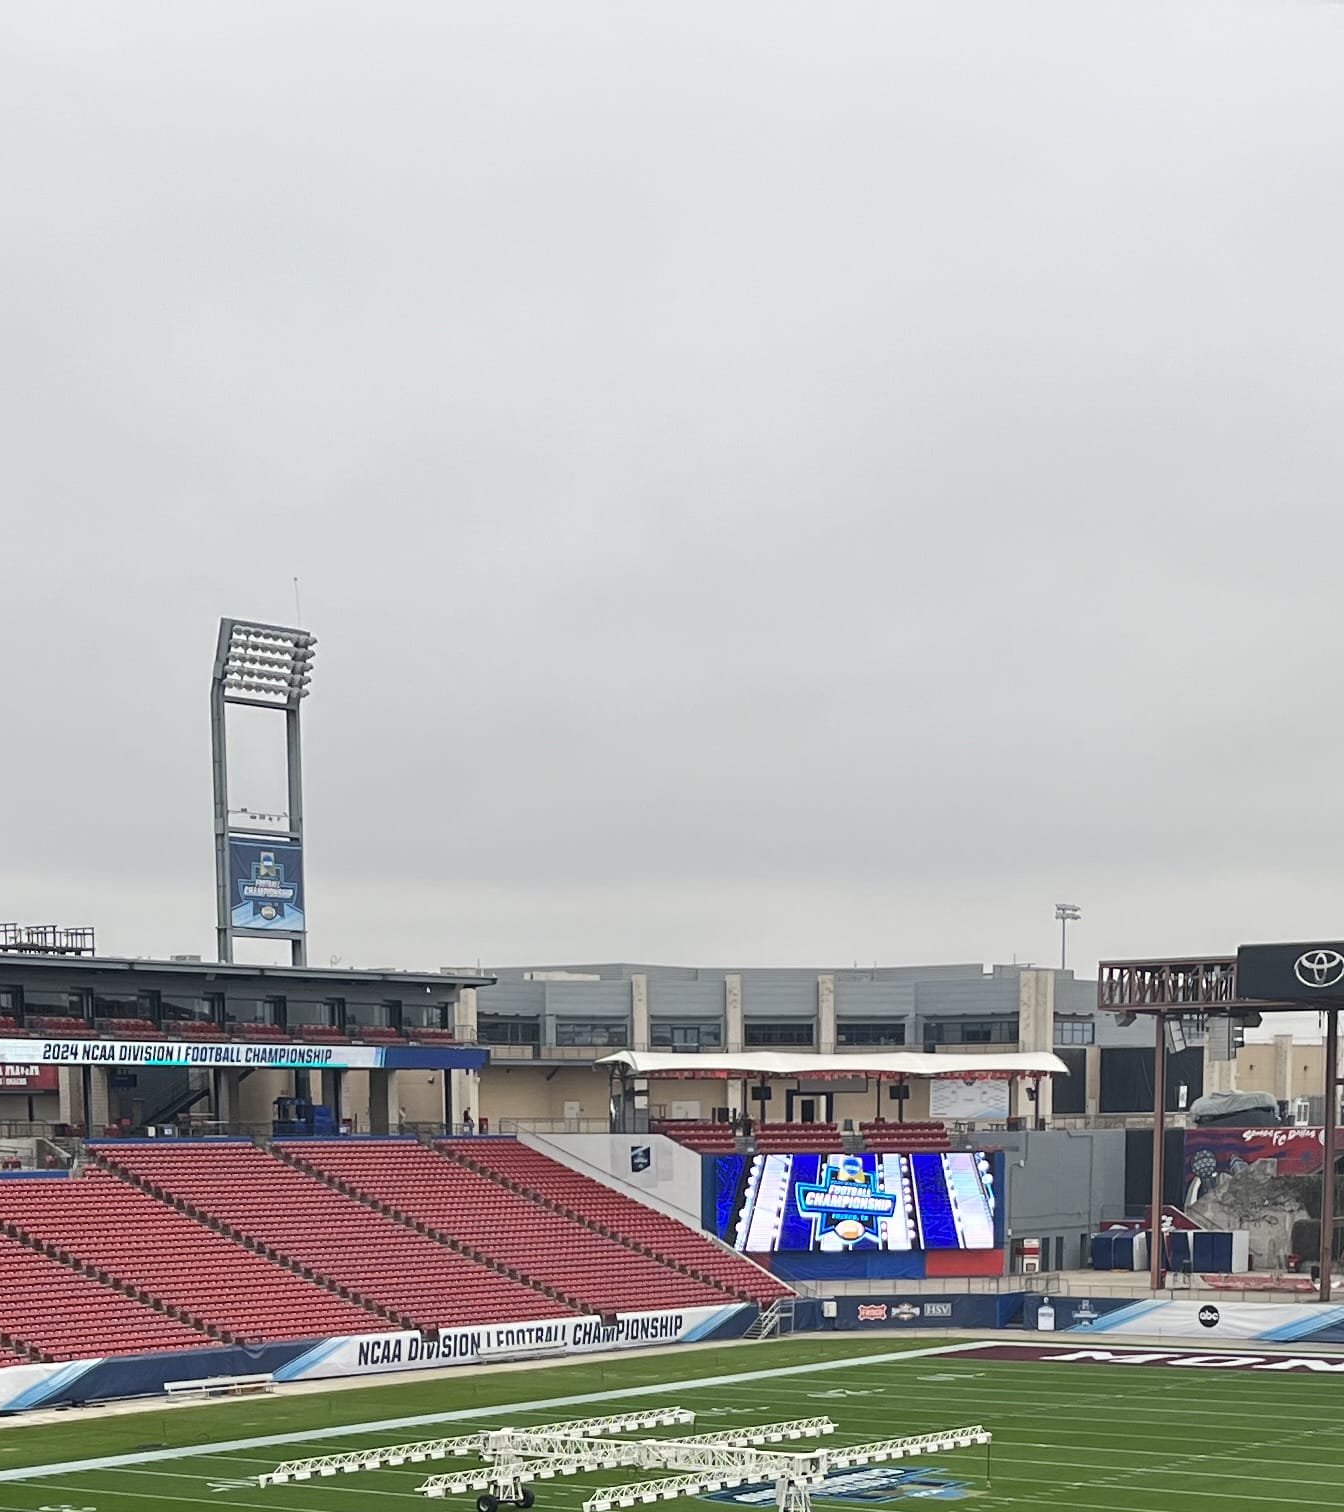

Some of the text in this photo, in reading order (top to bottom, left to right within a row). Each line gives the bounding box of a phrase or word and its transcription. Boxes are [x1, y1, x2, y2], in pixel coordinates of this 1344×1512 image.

[244, 886, 294, 899] CHAMPIONSHIP
[42, 1043, 80, 1060] 2024
[81, 1043, 116, 1061] NCAA
[119, 1044, 174, 1062] DIVISION
[184, 1046, 242, 1063] FOOTBALL
[244, 1047, 333, 1064] CHAMPIONSHIP
[828, 1184, 872, 1199] FOOTBALL
[805, 1192, 892, 1211] CHAMPIONSHIP
[1199, 1312, 1220, 1322] abc
[358, 1339, 401, 1366] NCAA
[407, 1331, 481, 1362] DIVISION
[572, 1314, 684, 1346] CHAMPIONSHIP
